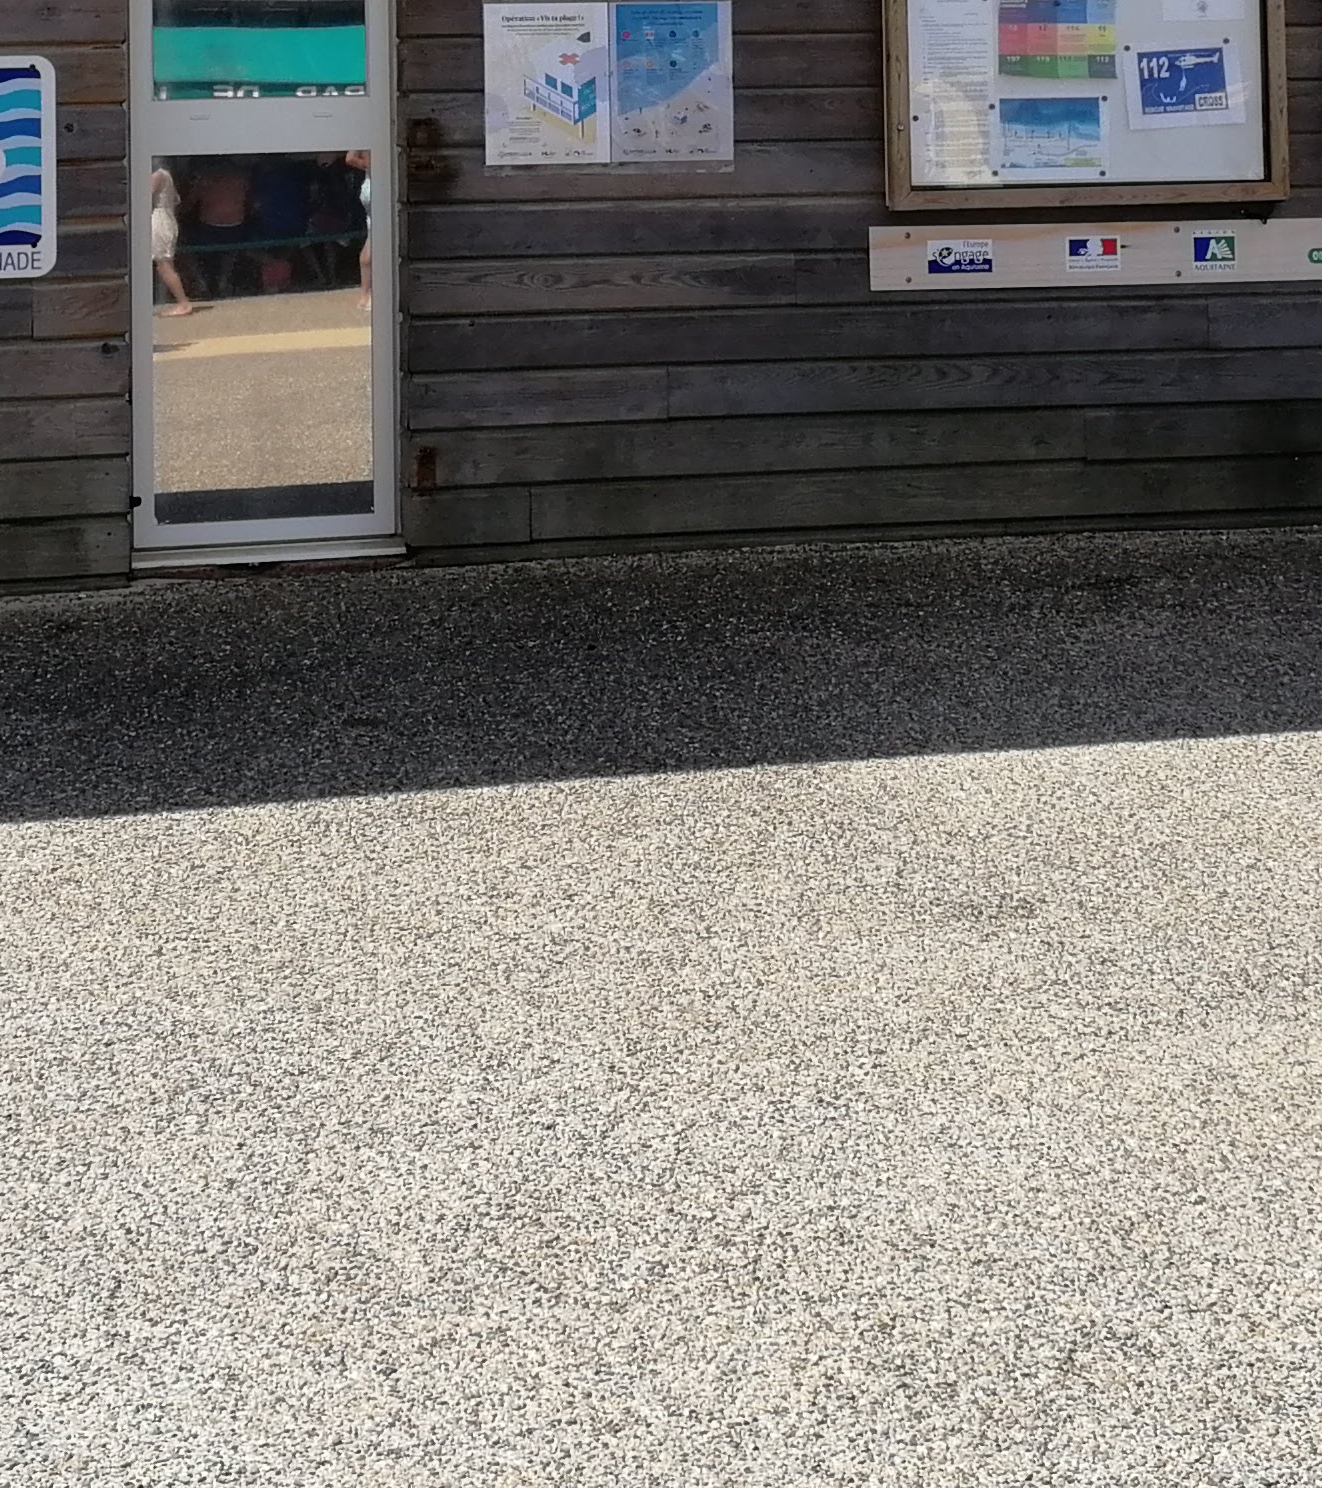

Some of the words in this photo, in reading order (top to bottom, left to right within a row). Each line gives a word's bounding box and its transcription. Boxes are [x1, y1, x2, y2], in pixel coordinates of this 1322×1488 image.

[1140, 57, 1170, 80] 112
[1198, 94, 1224, 108] CROSS
[1194, 263, 1236, 271] AQUITAINE
